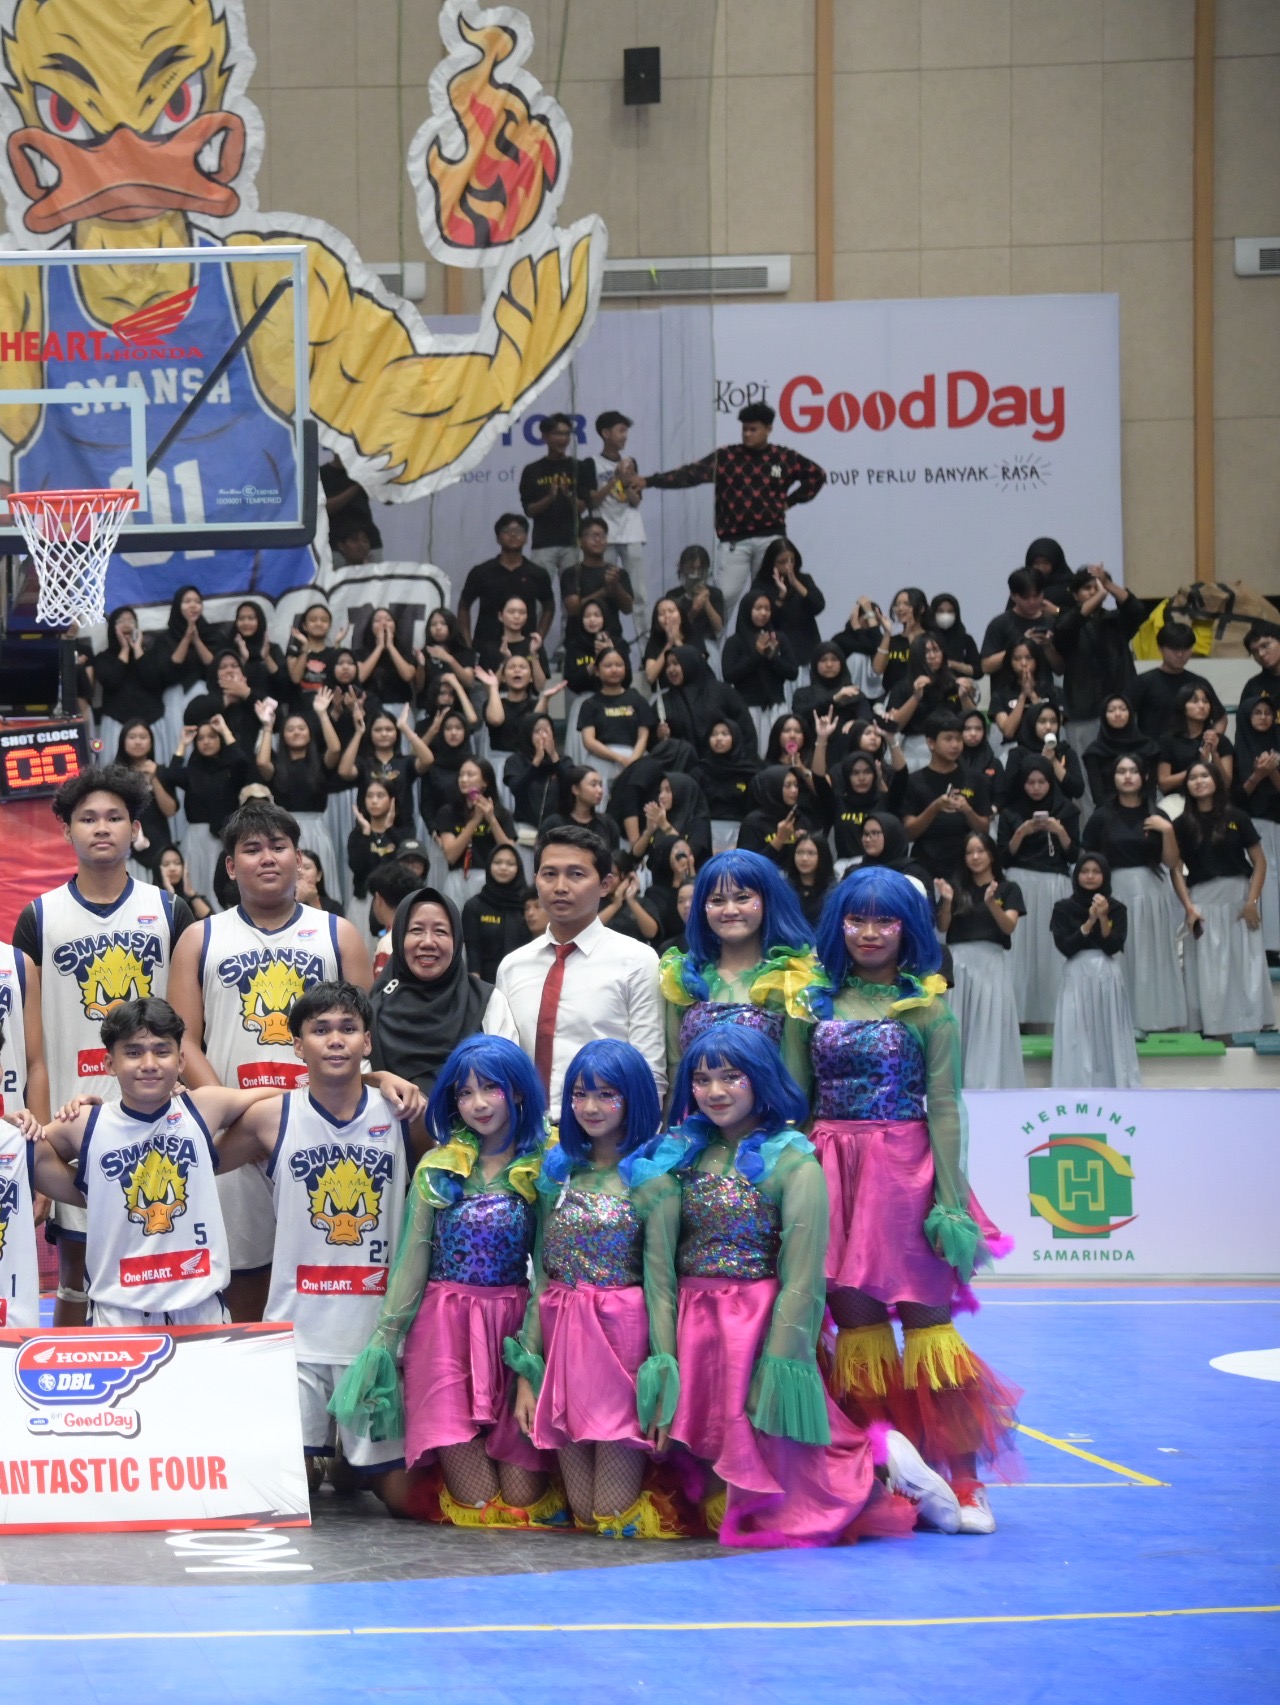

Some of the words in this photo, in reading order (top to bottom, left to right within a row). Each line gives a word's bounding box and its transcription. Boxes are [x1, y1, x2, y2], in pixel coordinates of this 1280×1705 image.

[0, 331, 111, 362] HEART.
[113, 346, 204, 361] HONDA
[779, 374, 936, 433] Good
[947, 371, 1065, 442] Day
[867, 468, 916, 484] PERLU
[925, 466, 989, 484] BANYAK
[1002, 465, 1040, 481] RASA
[0, 734, 35, 747] SHOT
[37, 729, 79, 743] CLOCK
[5, 744, 80, 788] 00
[52, 930, 164, 976] SMANSA
[217, 947, 325, 988] SMANSA
[81, 1063, 99, 1073] One
[4, 1070, 17, 1092] 2
[243, 1077, 257, 1087] One
[1021, 1103, 1137, 1137] HERMINA
[100, 1134, 198, 1181] SMANSA
[288, 1143, 395, 1184] SMANSA
[194, 1223, 207, 1245] 5
[1033, 1250, 1135, 1261] SAMARINDA
[12, 1273, 17, 1297] 1
[124, 1273, 141, 1283] One
[302, 1279, 318, 1290] One
[56, 1351, 134, 1363] HONDA
[57, 1373, 95, 1390] DBL
[64, 1413, 102, 1427] Good
[104, 1412, 133, 1429] Day
[149, 1456, 228, 1492] FOUR
